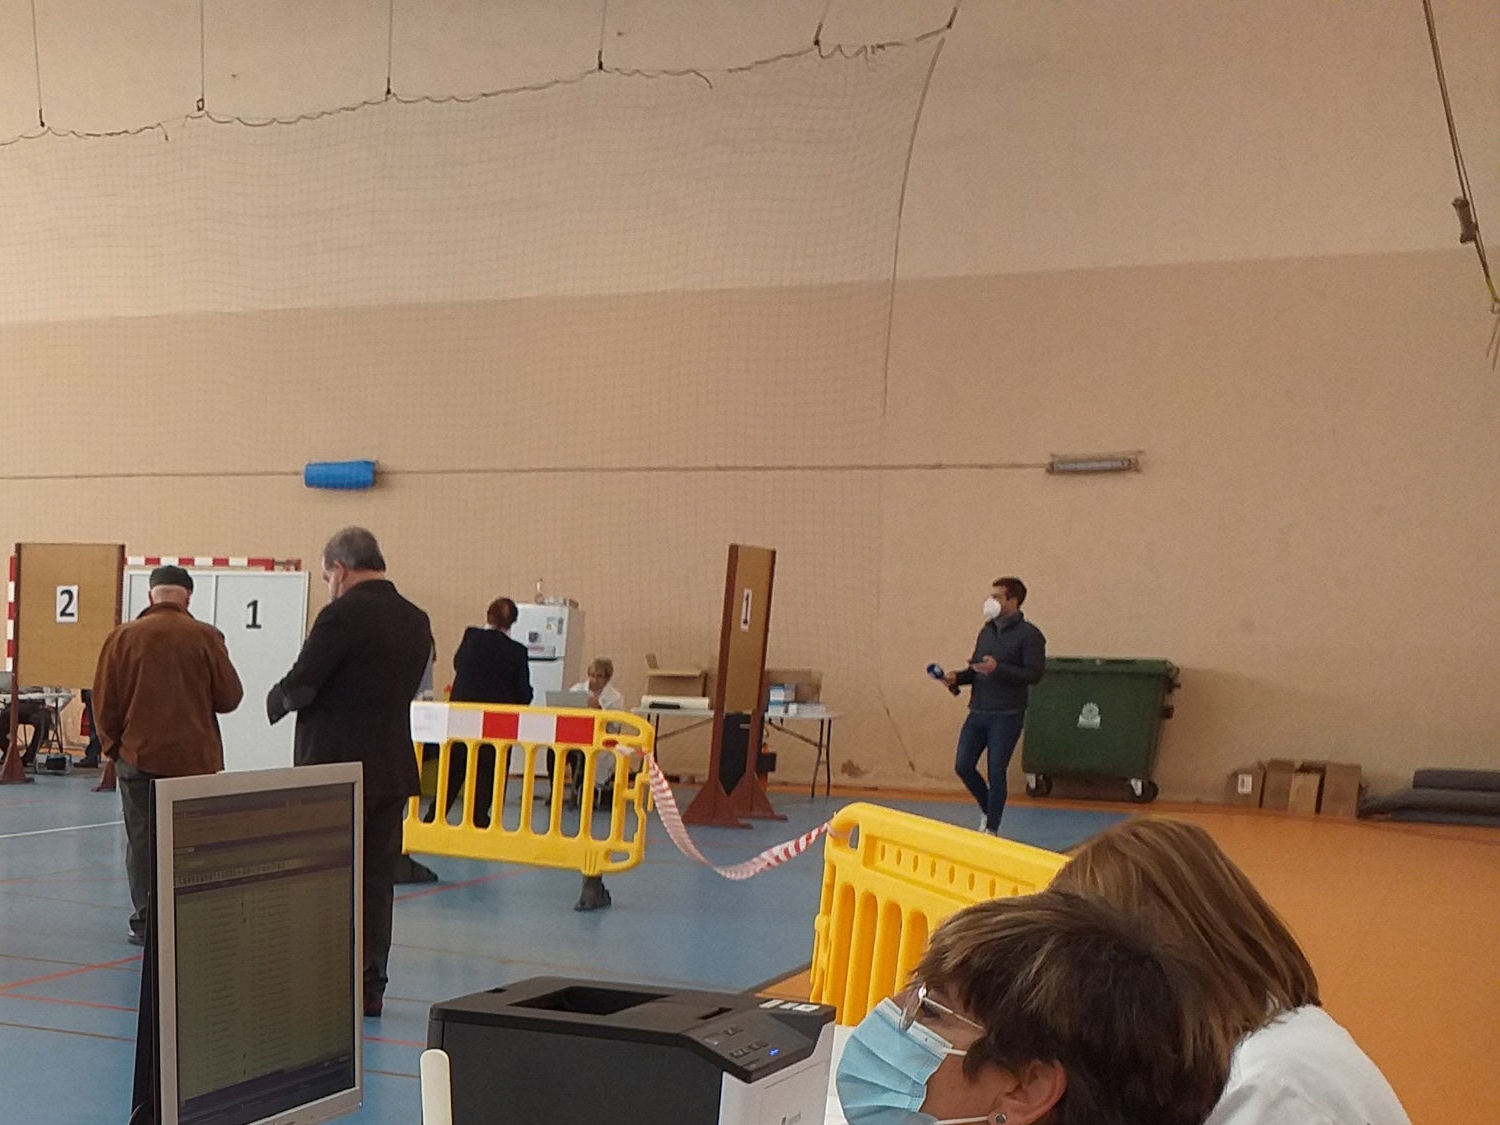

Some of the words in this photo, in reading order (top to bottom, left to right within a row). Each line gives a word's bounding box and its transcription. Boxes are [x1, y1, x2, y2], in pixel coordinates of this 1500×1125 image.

[59, 589, 75, 618] 2
[245, 600, 262, 629] 1
[742, 591, 750, 625] 1
